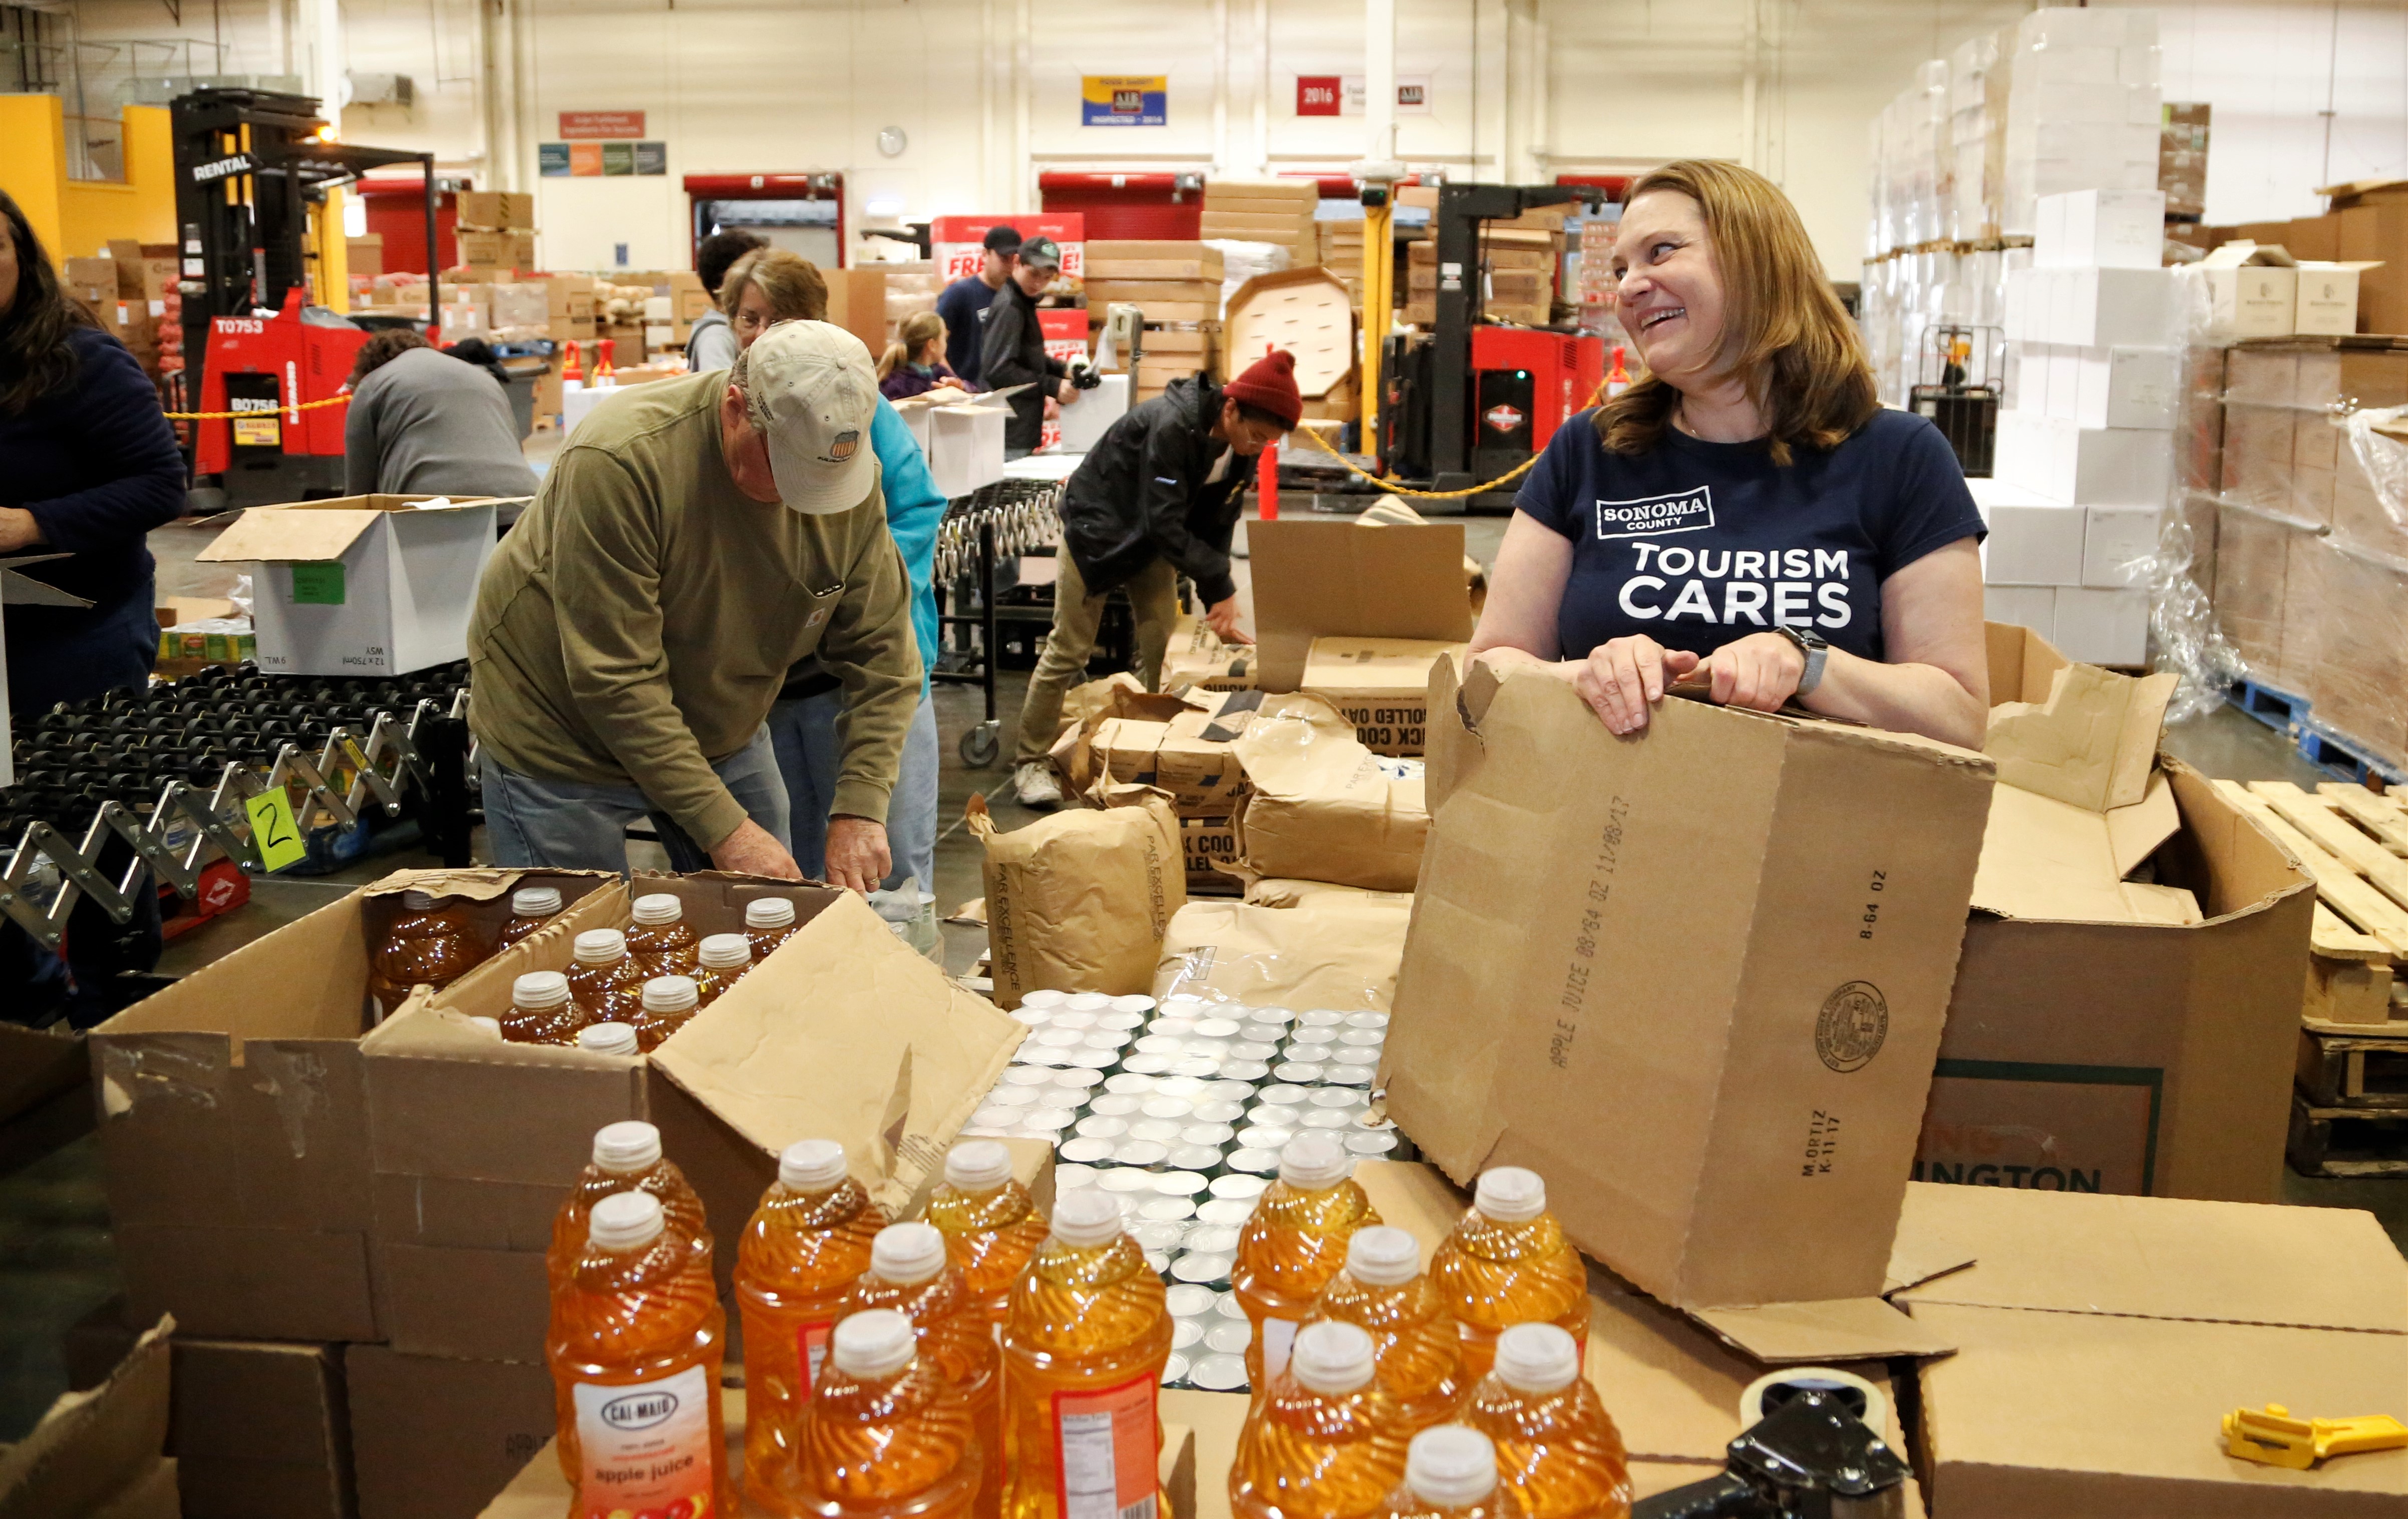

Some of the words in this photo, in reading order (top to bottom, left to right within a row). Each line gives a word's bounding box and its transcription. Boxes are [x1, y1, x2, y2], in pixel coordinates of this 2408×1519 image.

[1304, 87, 1333, 104] 2016
[193, 155, 252, 181] RENTAL
[216, 319, 264, 334] T0753
[1604, 498, 1706, 522] SONOMA
[1626, 517, 1682, 531] COUNTY
[1631, 542, 1850, 580] TOURISM
[1618, 575, 1852, 629] CARES
[342, 657, 366, 665] 750ml
[366, 647, 384, 655] WSY
[1374, 708, 1426, 724] OLLED
[1356, 727, 1391, 745] COO
[256, 803, 292, 848] 2
[1198, 835, 1234, 854] COO
[1589, 880, 1609, 901] OZ
[1860, 904, 1879, 939] 8-64
[1871, 870, 1886, 891] OZ
[1001, 897, 1020, 991] EXCELLENCE
[1561, 962, 1590, 1012] JUICE
[1549, 1019, 1575, 1069] APPLE
[1914, 1161, 2101, 1193] INGTON
[596, 1468, 644, 1484] apple
